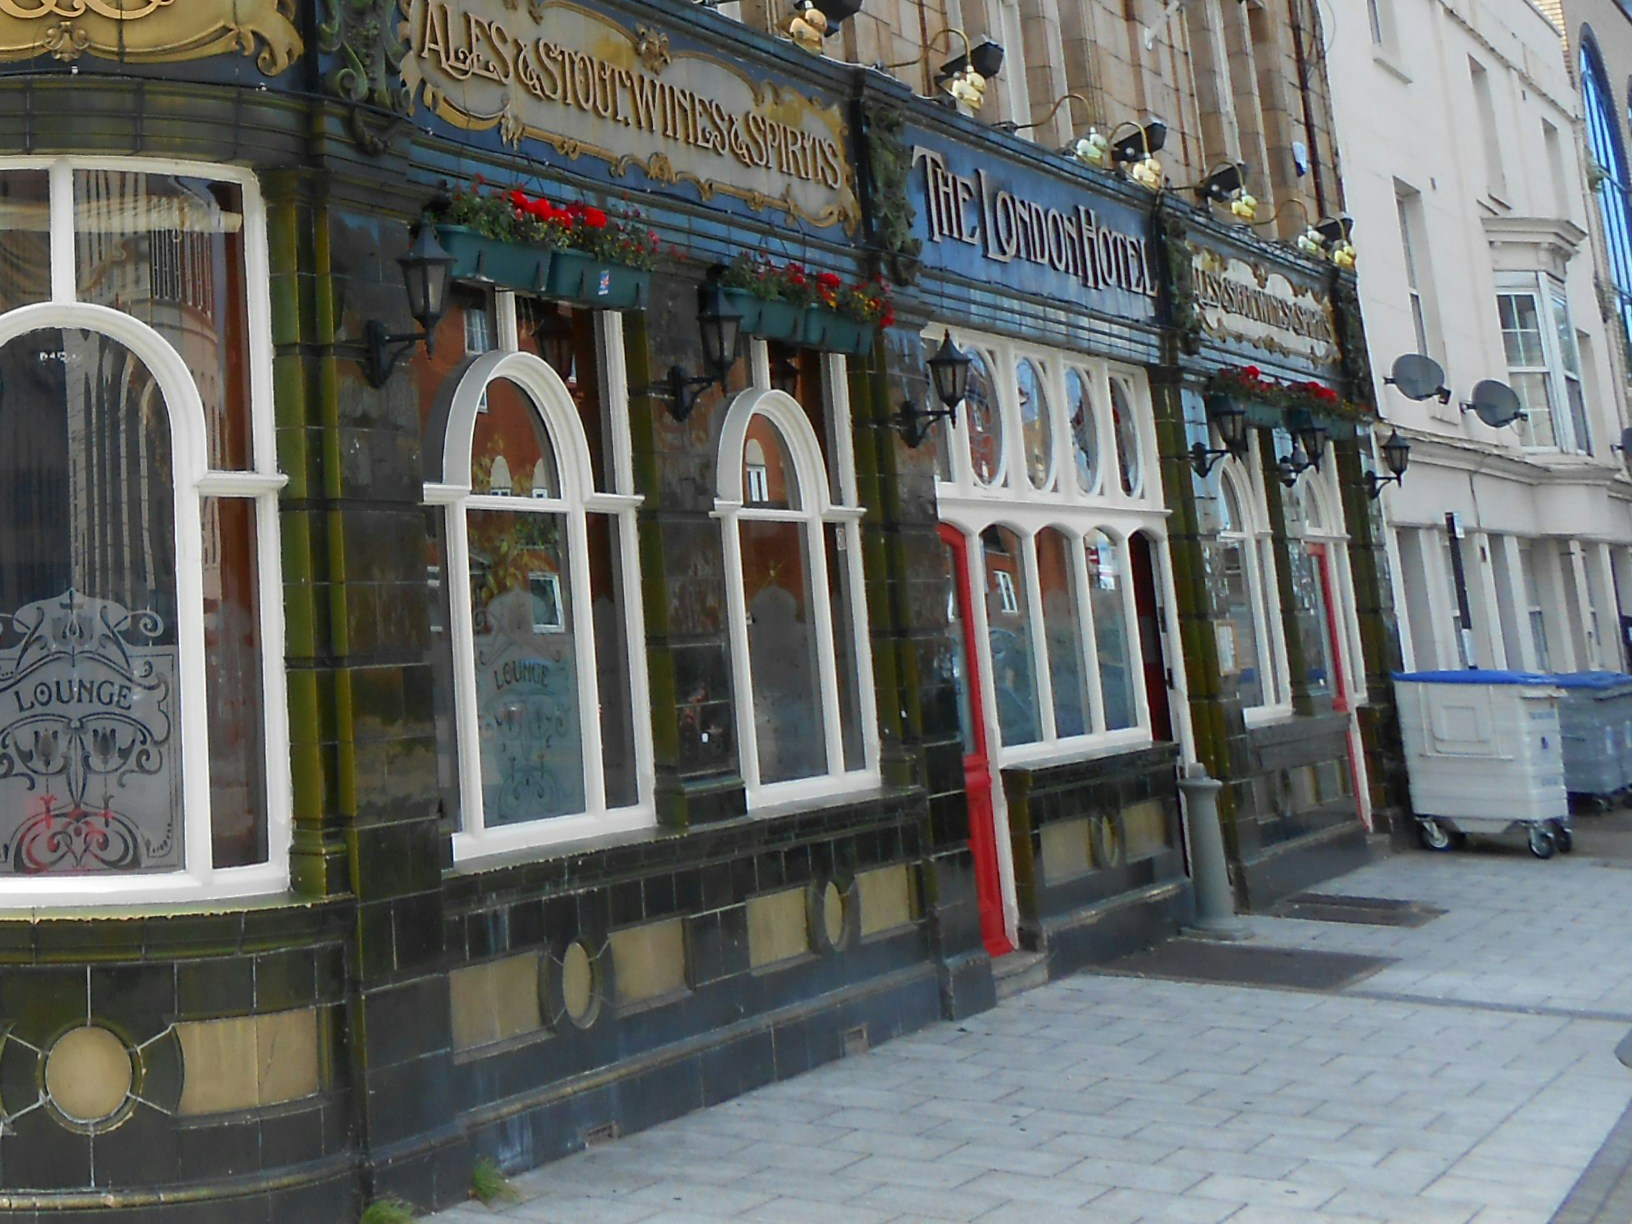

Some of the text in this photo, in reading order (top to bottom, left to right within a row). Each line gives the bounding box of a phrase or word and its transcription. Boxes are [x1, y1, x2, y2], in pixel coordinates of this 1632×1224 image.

[419, 0, 513, 85] ALES
[628, 74, 729, 156] WINES
[746, 112, 842, 189] SPIRITS
[911, 145, 1159, 297] THE LONDON HOTEL
[14, 678, 132, 712] LOUNGE
